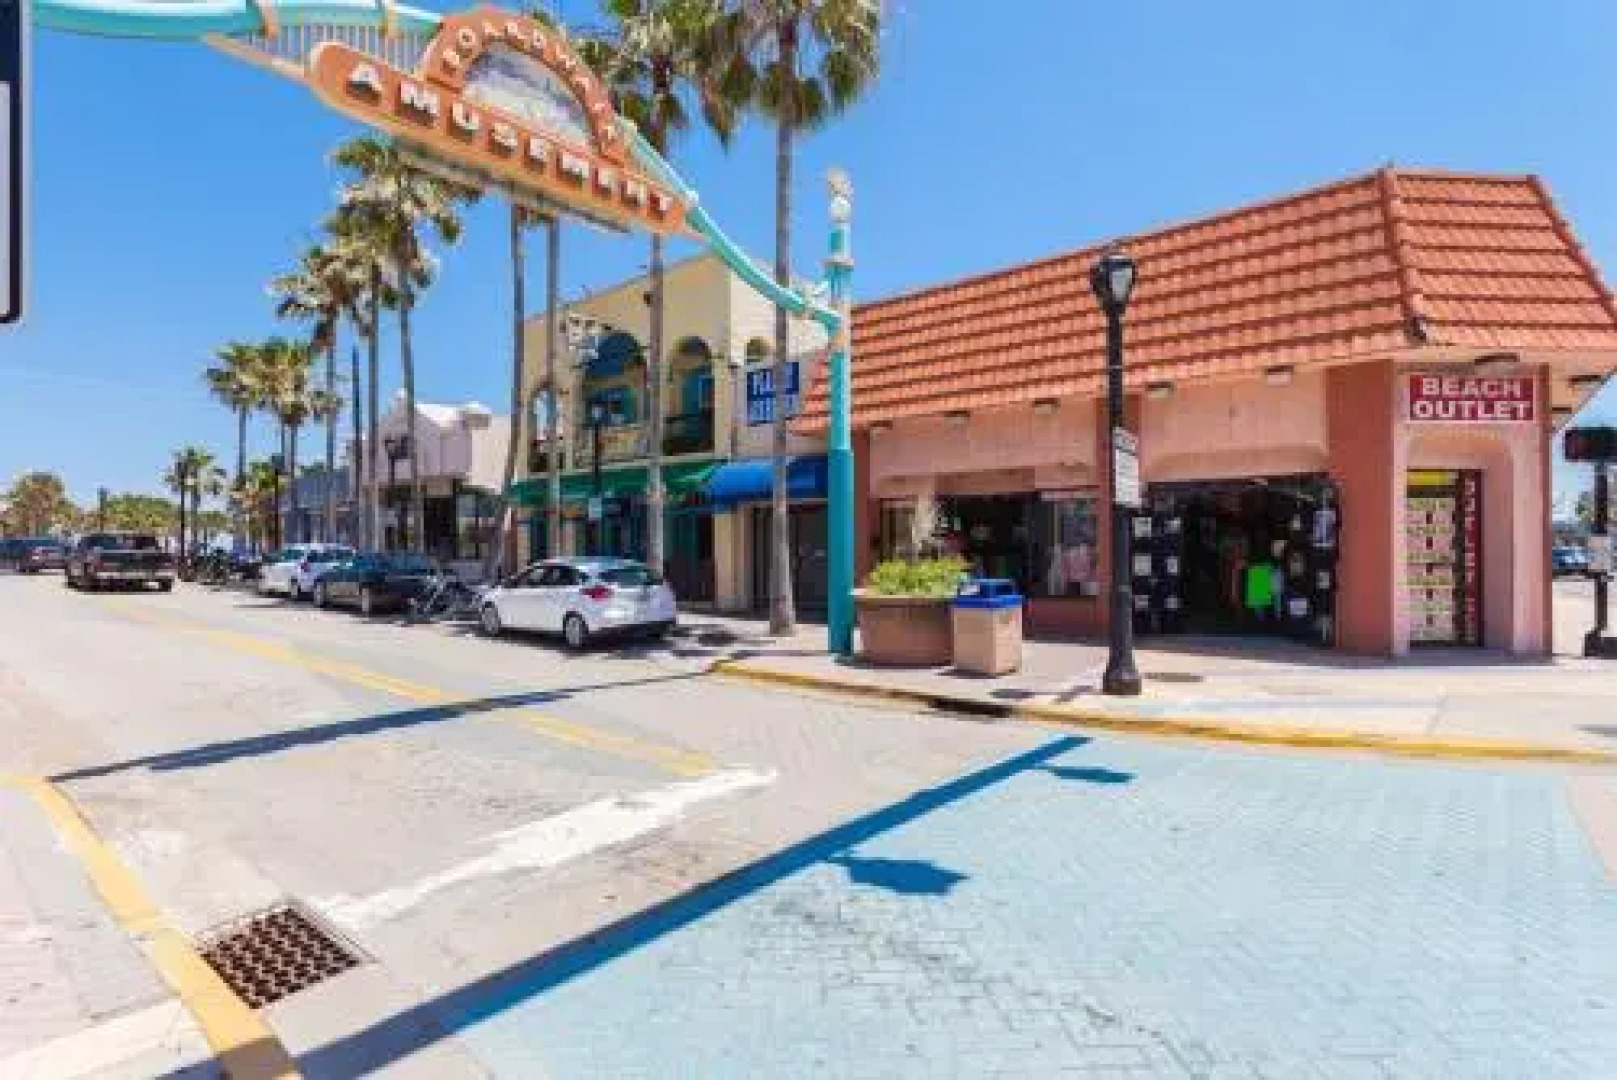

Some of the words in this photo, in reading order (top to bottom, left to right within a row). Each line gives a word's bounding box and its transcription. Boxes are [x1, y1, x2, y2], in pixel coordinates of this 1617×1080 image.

[346, 61, 675, 221] AMUSEMENT
[1421, 376, 1521, 398] BEACH
[1413, 399, 1531, 418] OUTLET
